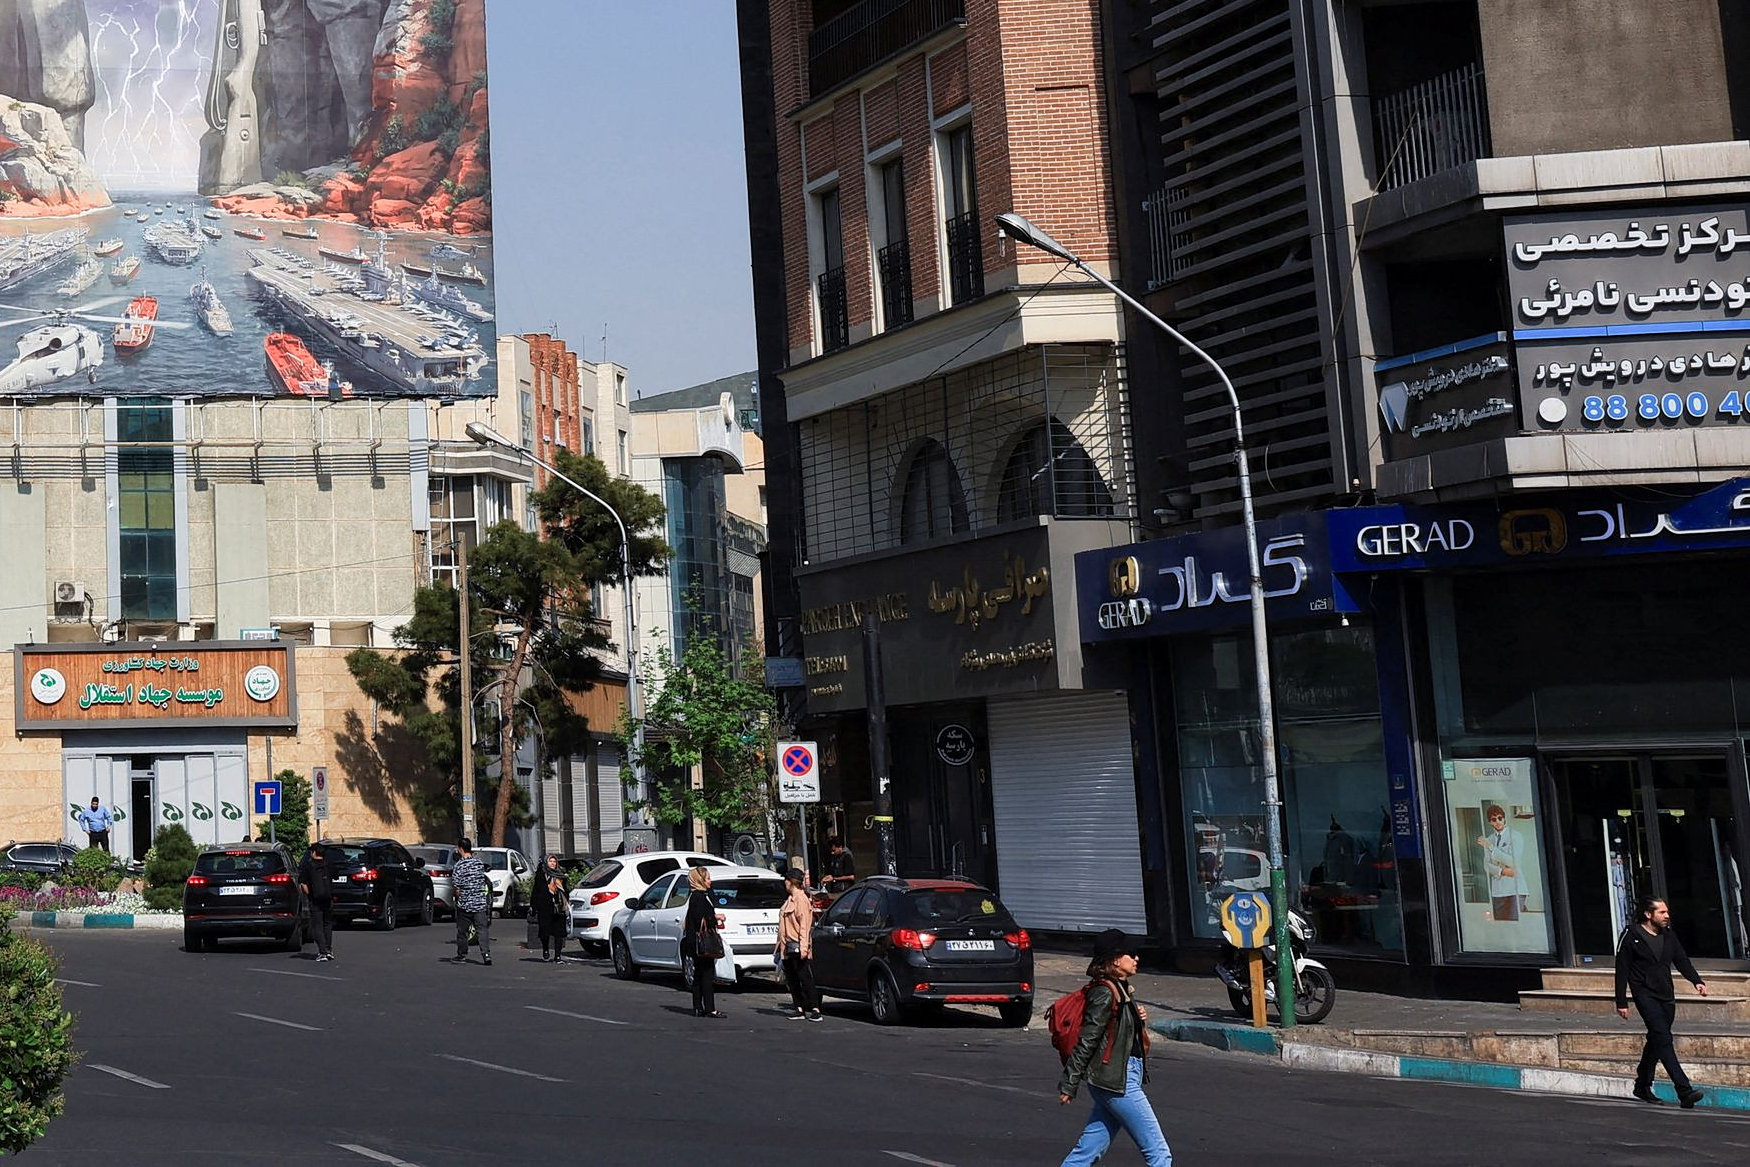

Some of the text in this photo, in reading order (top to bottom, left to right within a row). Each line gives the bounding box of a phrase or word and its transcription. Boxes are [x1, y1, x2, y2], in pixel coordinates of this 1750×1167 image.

[1515, 216, 1750, 262] رکز تخصصی
[1521, 277, 1750, 317] ودنسی نامرئی
[1536, 362, 1576, 387] پور
[1581, 346, 1664, 381] درویش
[1669, 351, 1737, 374] هادی
[1583, 391, 1750, 421] 88 800 4
[1357, 519, 1475, 555] GERAD
[1098, 598, 1151, 629] GERAD
[102, 656, 200, 673] وزارت جهاد کشاورزی
[79, 682, 134, 709] استقلال
[137, 682, 173, 709] جهاد
[176, 685, 224, 708] موسسه
[1481, 767, 1512, 777] GERAD
